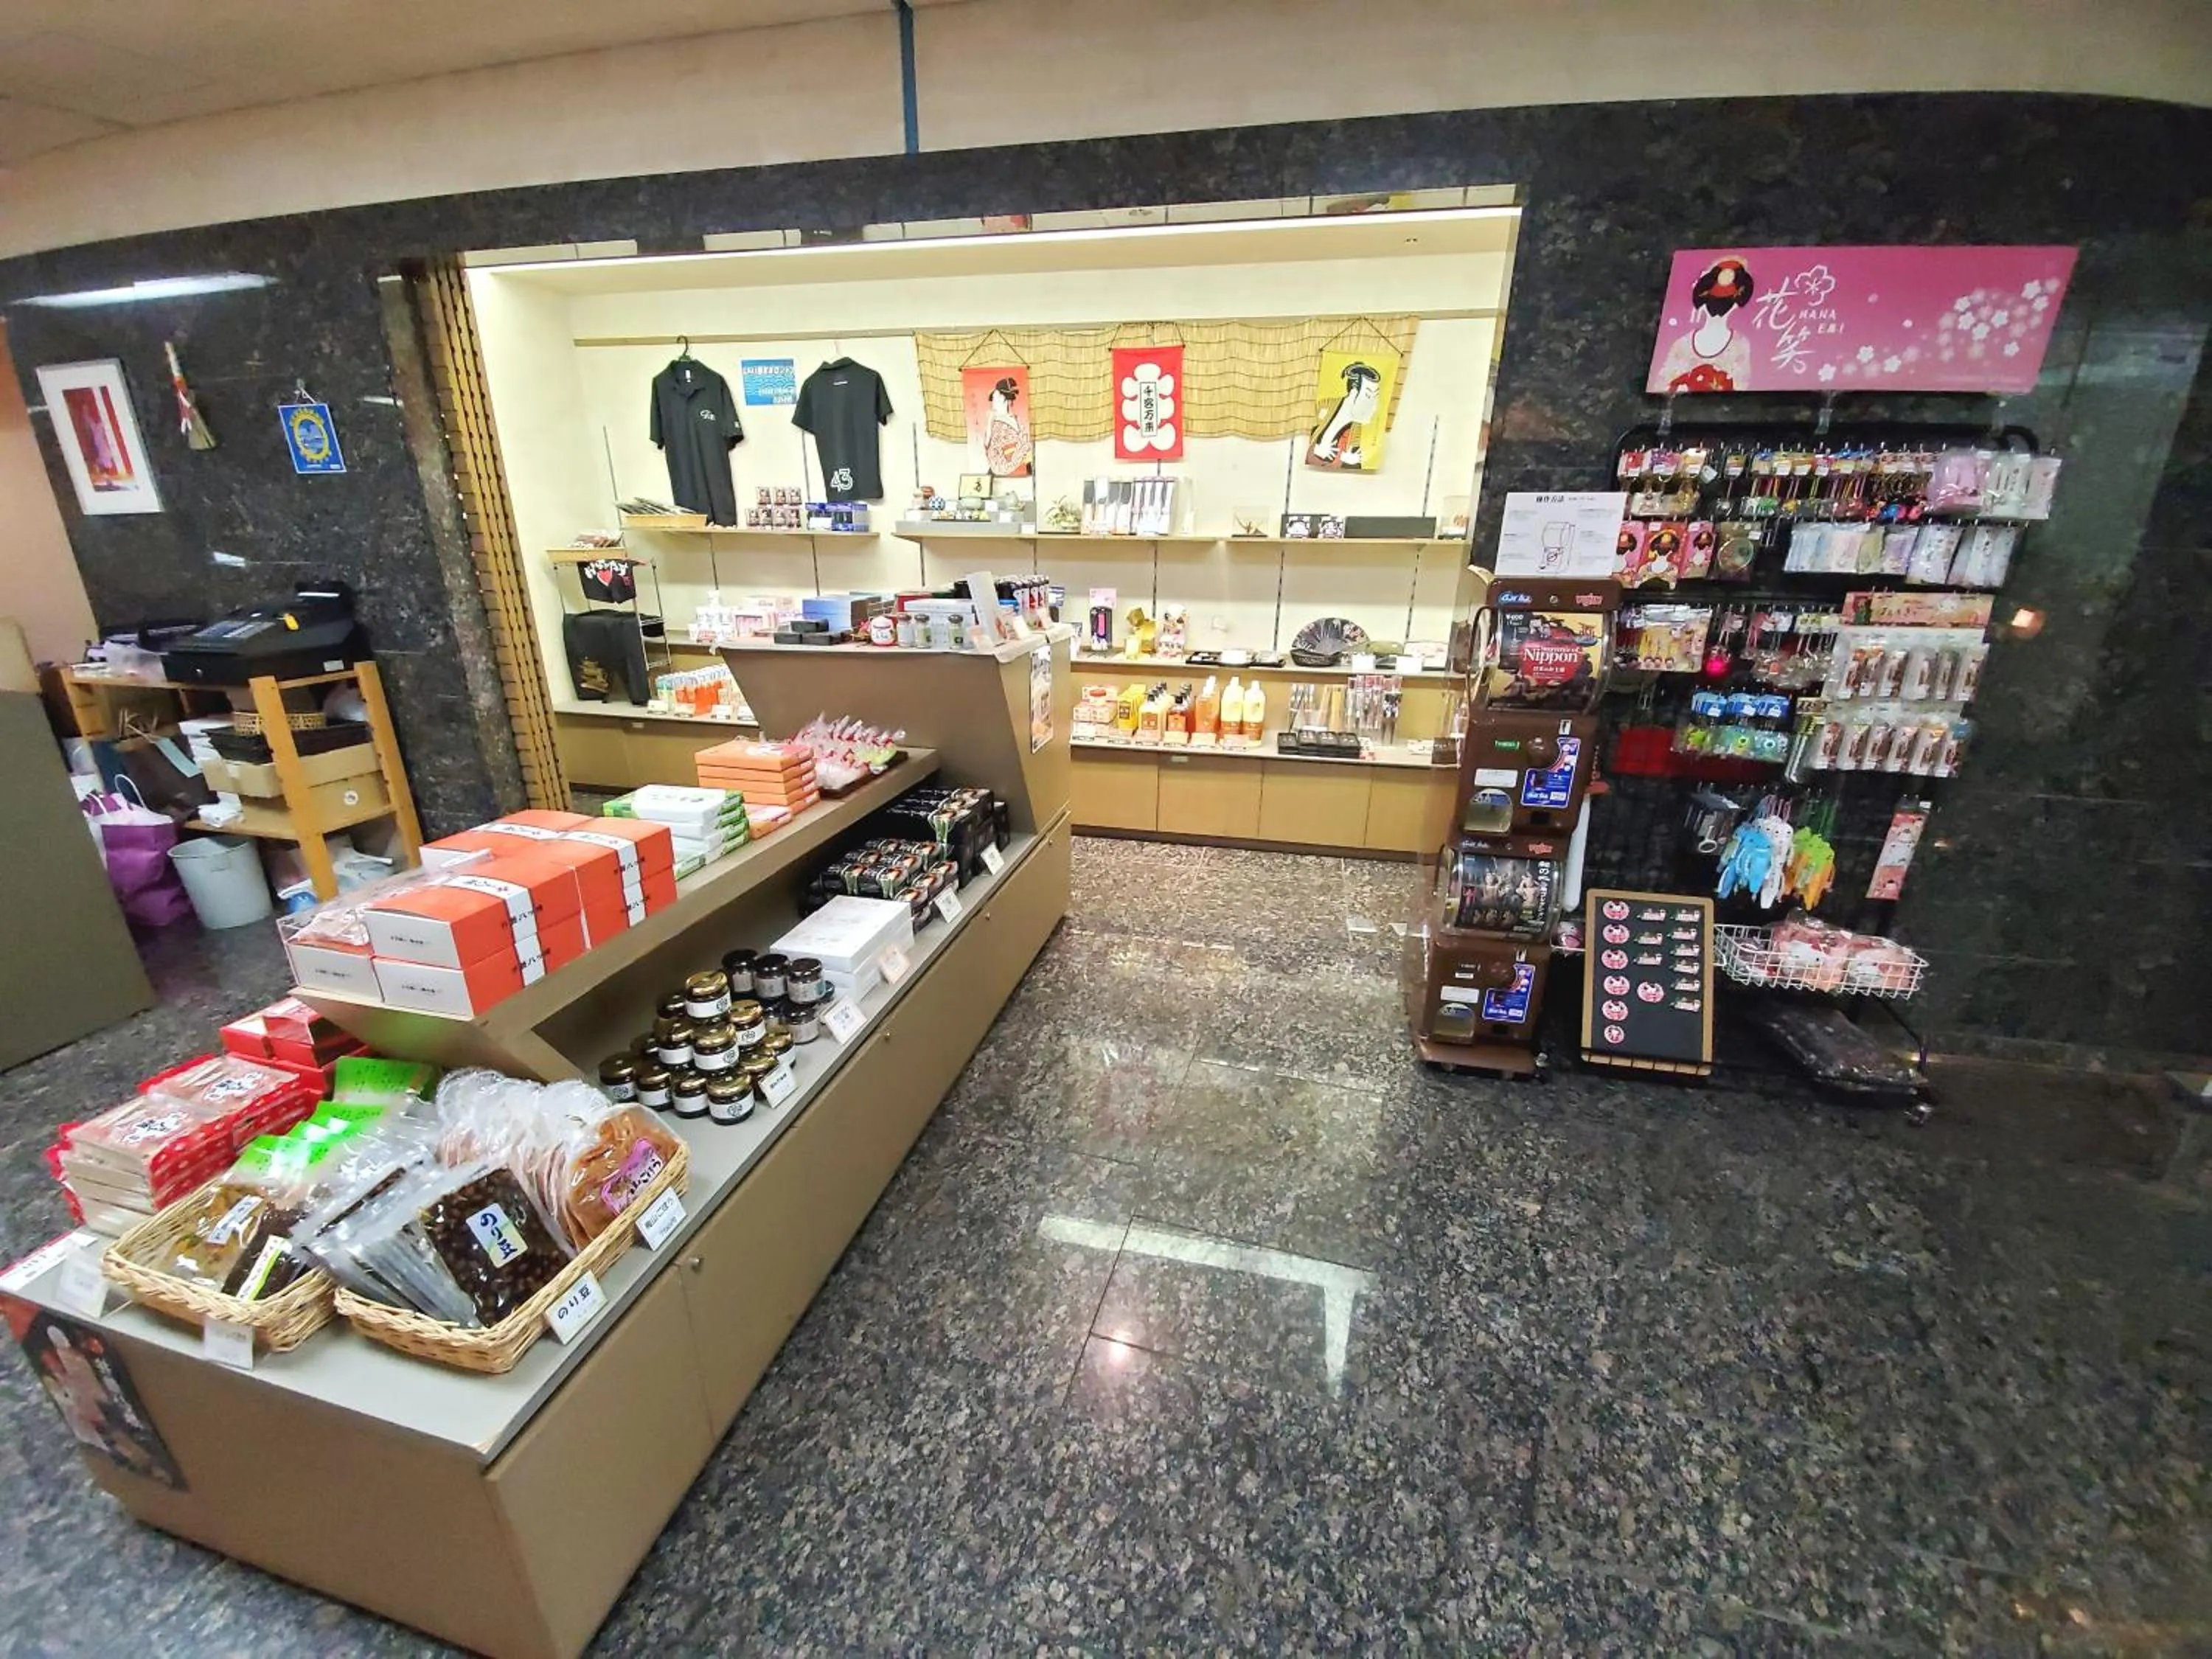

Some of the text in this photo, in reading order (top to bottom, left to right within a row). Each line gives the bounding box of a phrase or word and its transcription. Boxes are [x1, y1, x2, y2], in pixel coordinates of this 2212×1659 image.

[1799, 309, 1836, 320] HANA
[1523, 648, 1579, 665] Nippon
[480, 1213, 518, 1260] のり豆
[557, 1284, 592, 1320] のり豆
